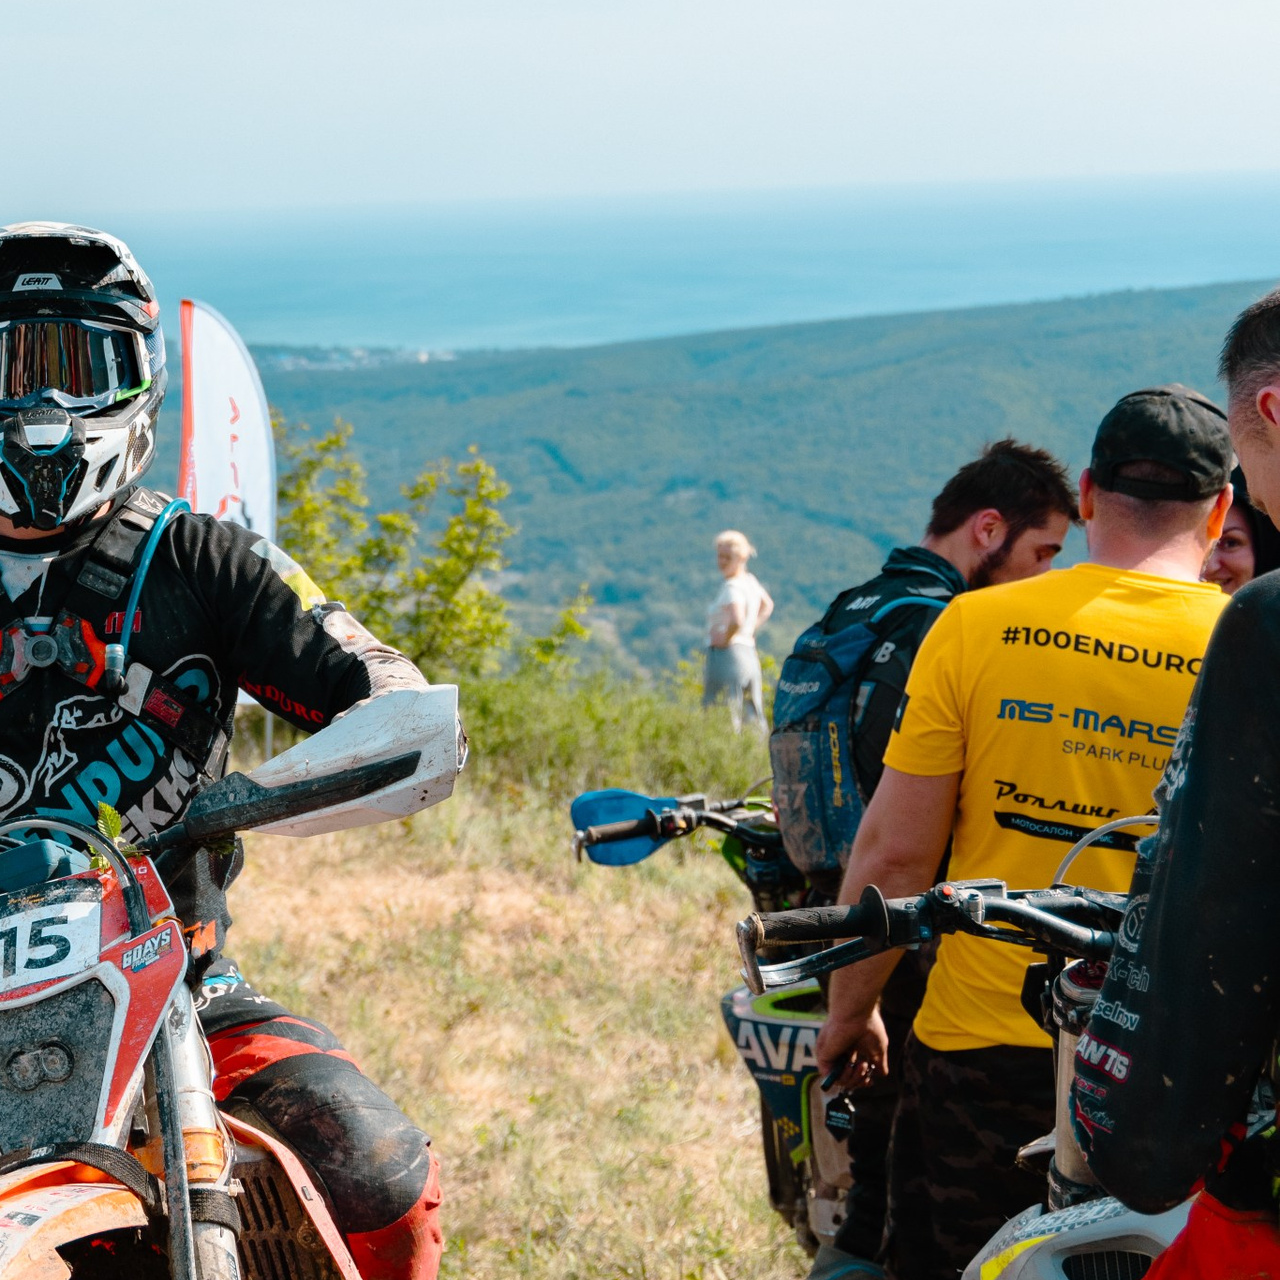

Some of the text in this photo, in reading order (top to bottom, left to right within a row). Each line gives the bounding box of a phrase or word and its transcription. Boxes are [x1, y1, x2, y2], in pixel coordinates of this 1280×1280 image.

[21, 276, 53, 287] LEATT
[1062, 739, 1123, 763] SPARK
[1011, 817, 1074, 838] МОТОСАЛОН
[122, 928, 172, 968] 6DAYS
